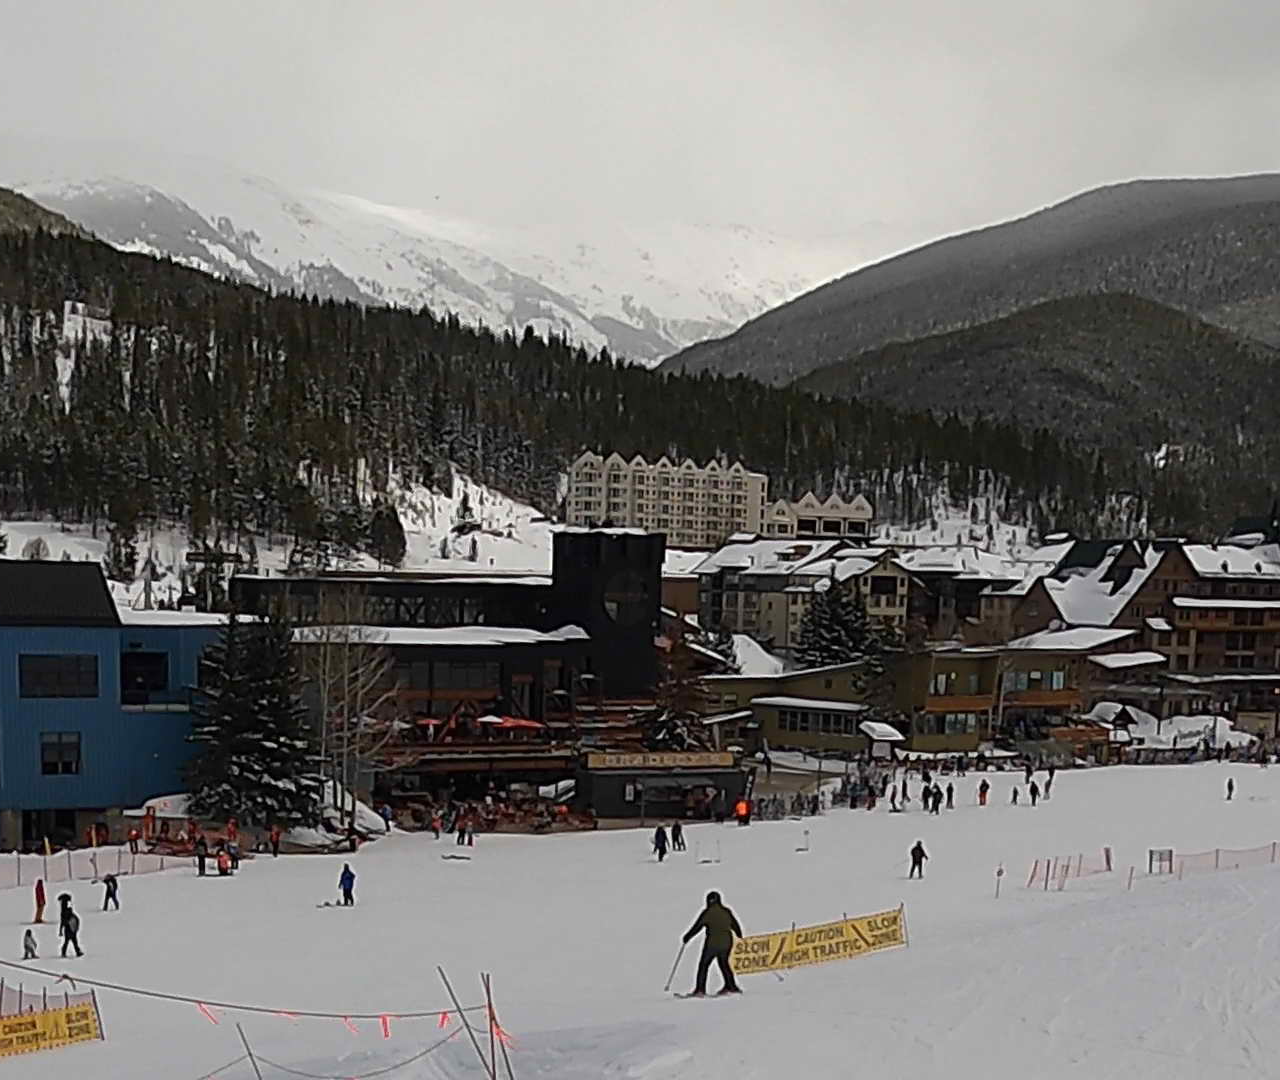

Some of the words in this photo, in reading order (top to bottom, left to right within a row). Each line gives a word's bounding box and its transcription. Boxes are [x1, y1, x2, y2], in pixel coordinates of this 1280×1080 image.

[867, 915, 898, 932] SLOW
[795, 927, 844, 946] CAUTION
[871, 929, 899, 946] ZONE
[734, 939, 770, 955] SLOW
[781, 948, 810, 964] HIGH
[812, 939, 862, 958] TRAFFIC
[734, 955, 770, 970] ZONE
[64, 1010, 89, 1024] SLOW
[2, 1020, 38, 1035] CAUTION
[67, 1023, 91, 1038] ZONE
[14, 1031, 48, 1046] TRAFFIC
